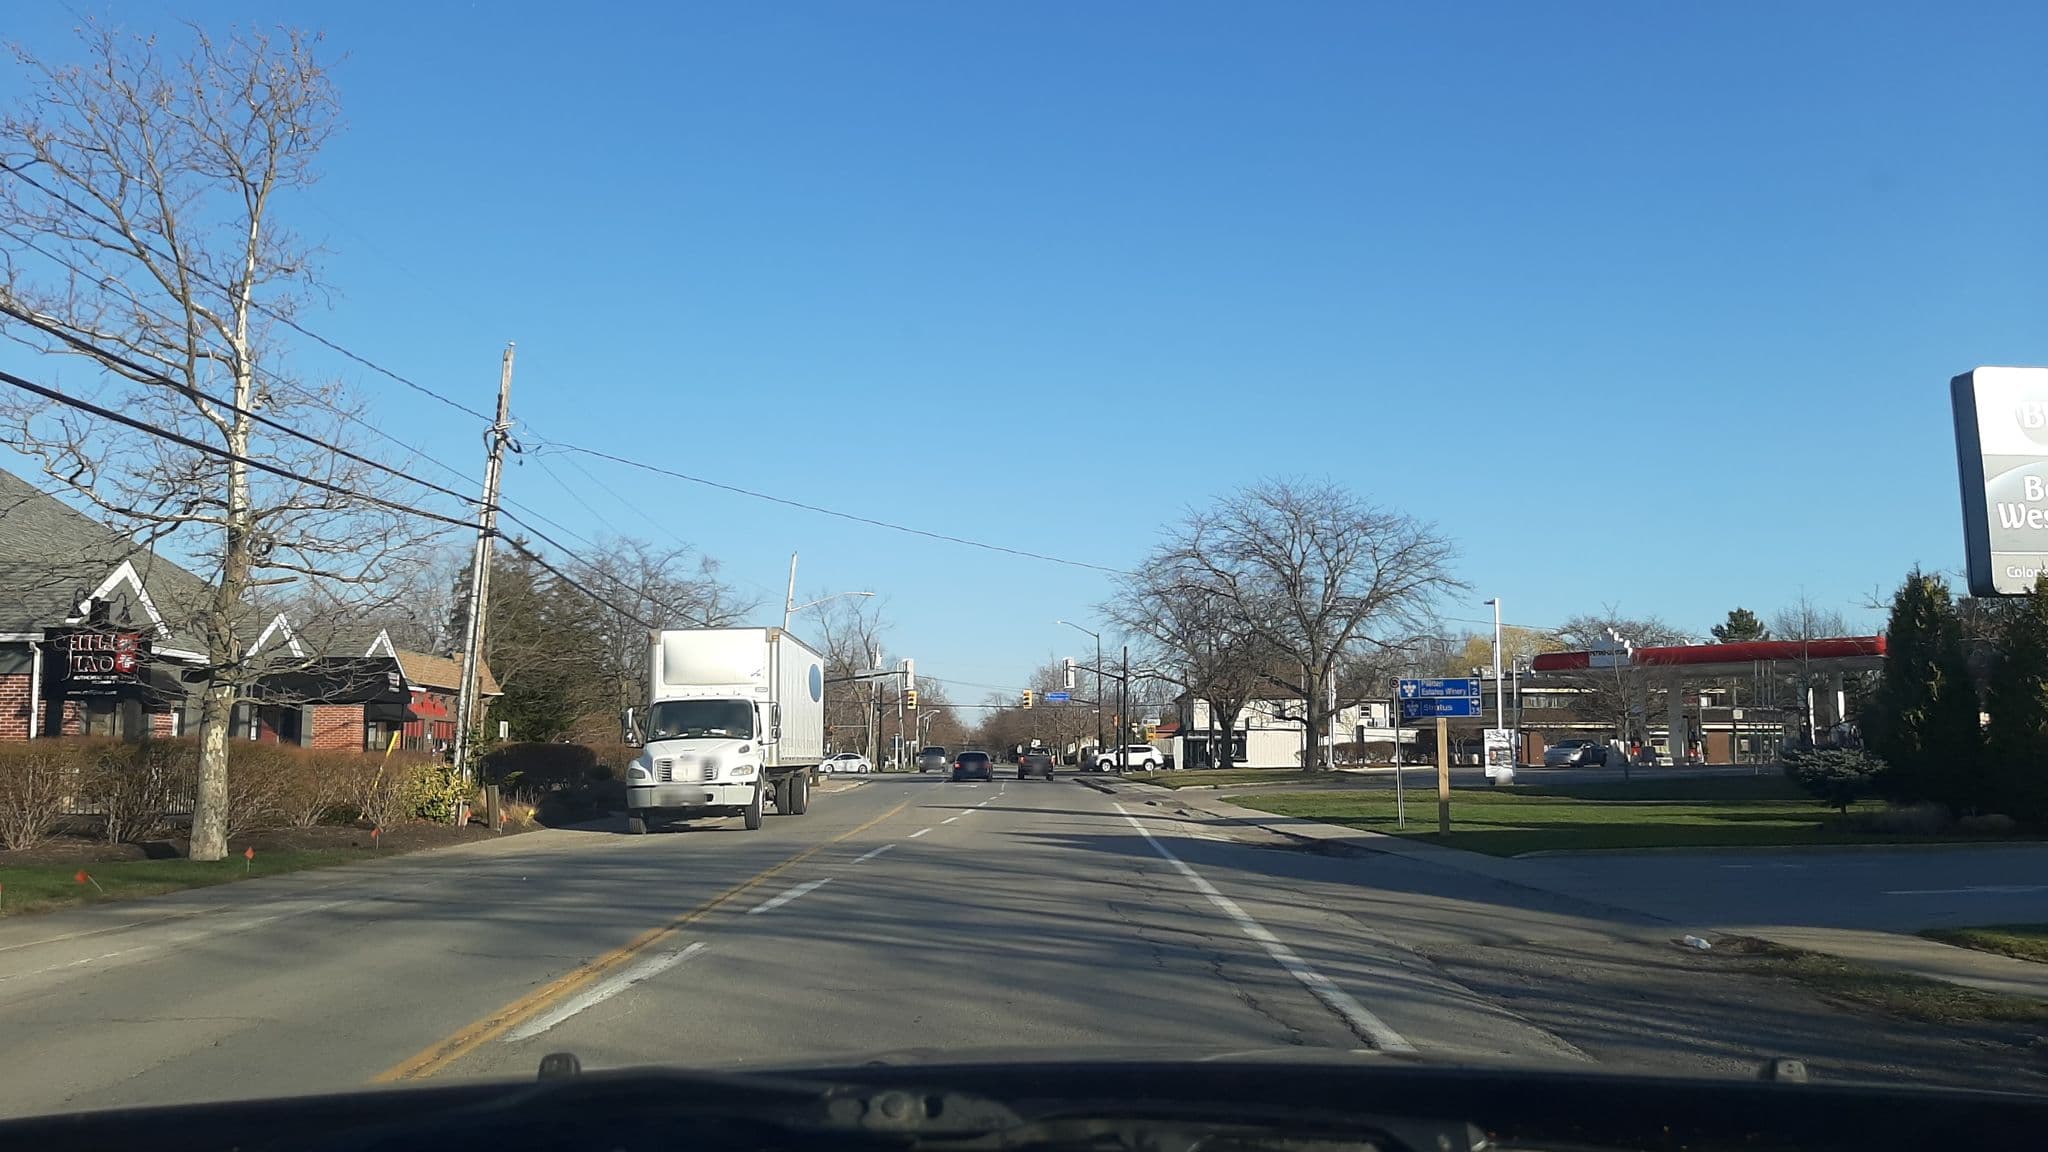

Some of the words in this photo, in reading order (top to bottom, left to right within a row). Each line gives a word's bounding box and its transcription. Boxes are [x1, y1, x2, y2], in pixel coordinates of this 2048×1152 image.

[2022, 401, 2048, 429] B
[2023, 475, 2048, 501] B
[1471, 687, 1478, 695] 2
